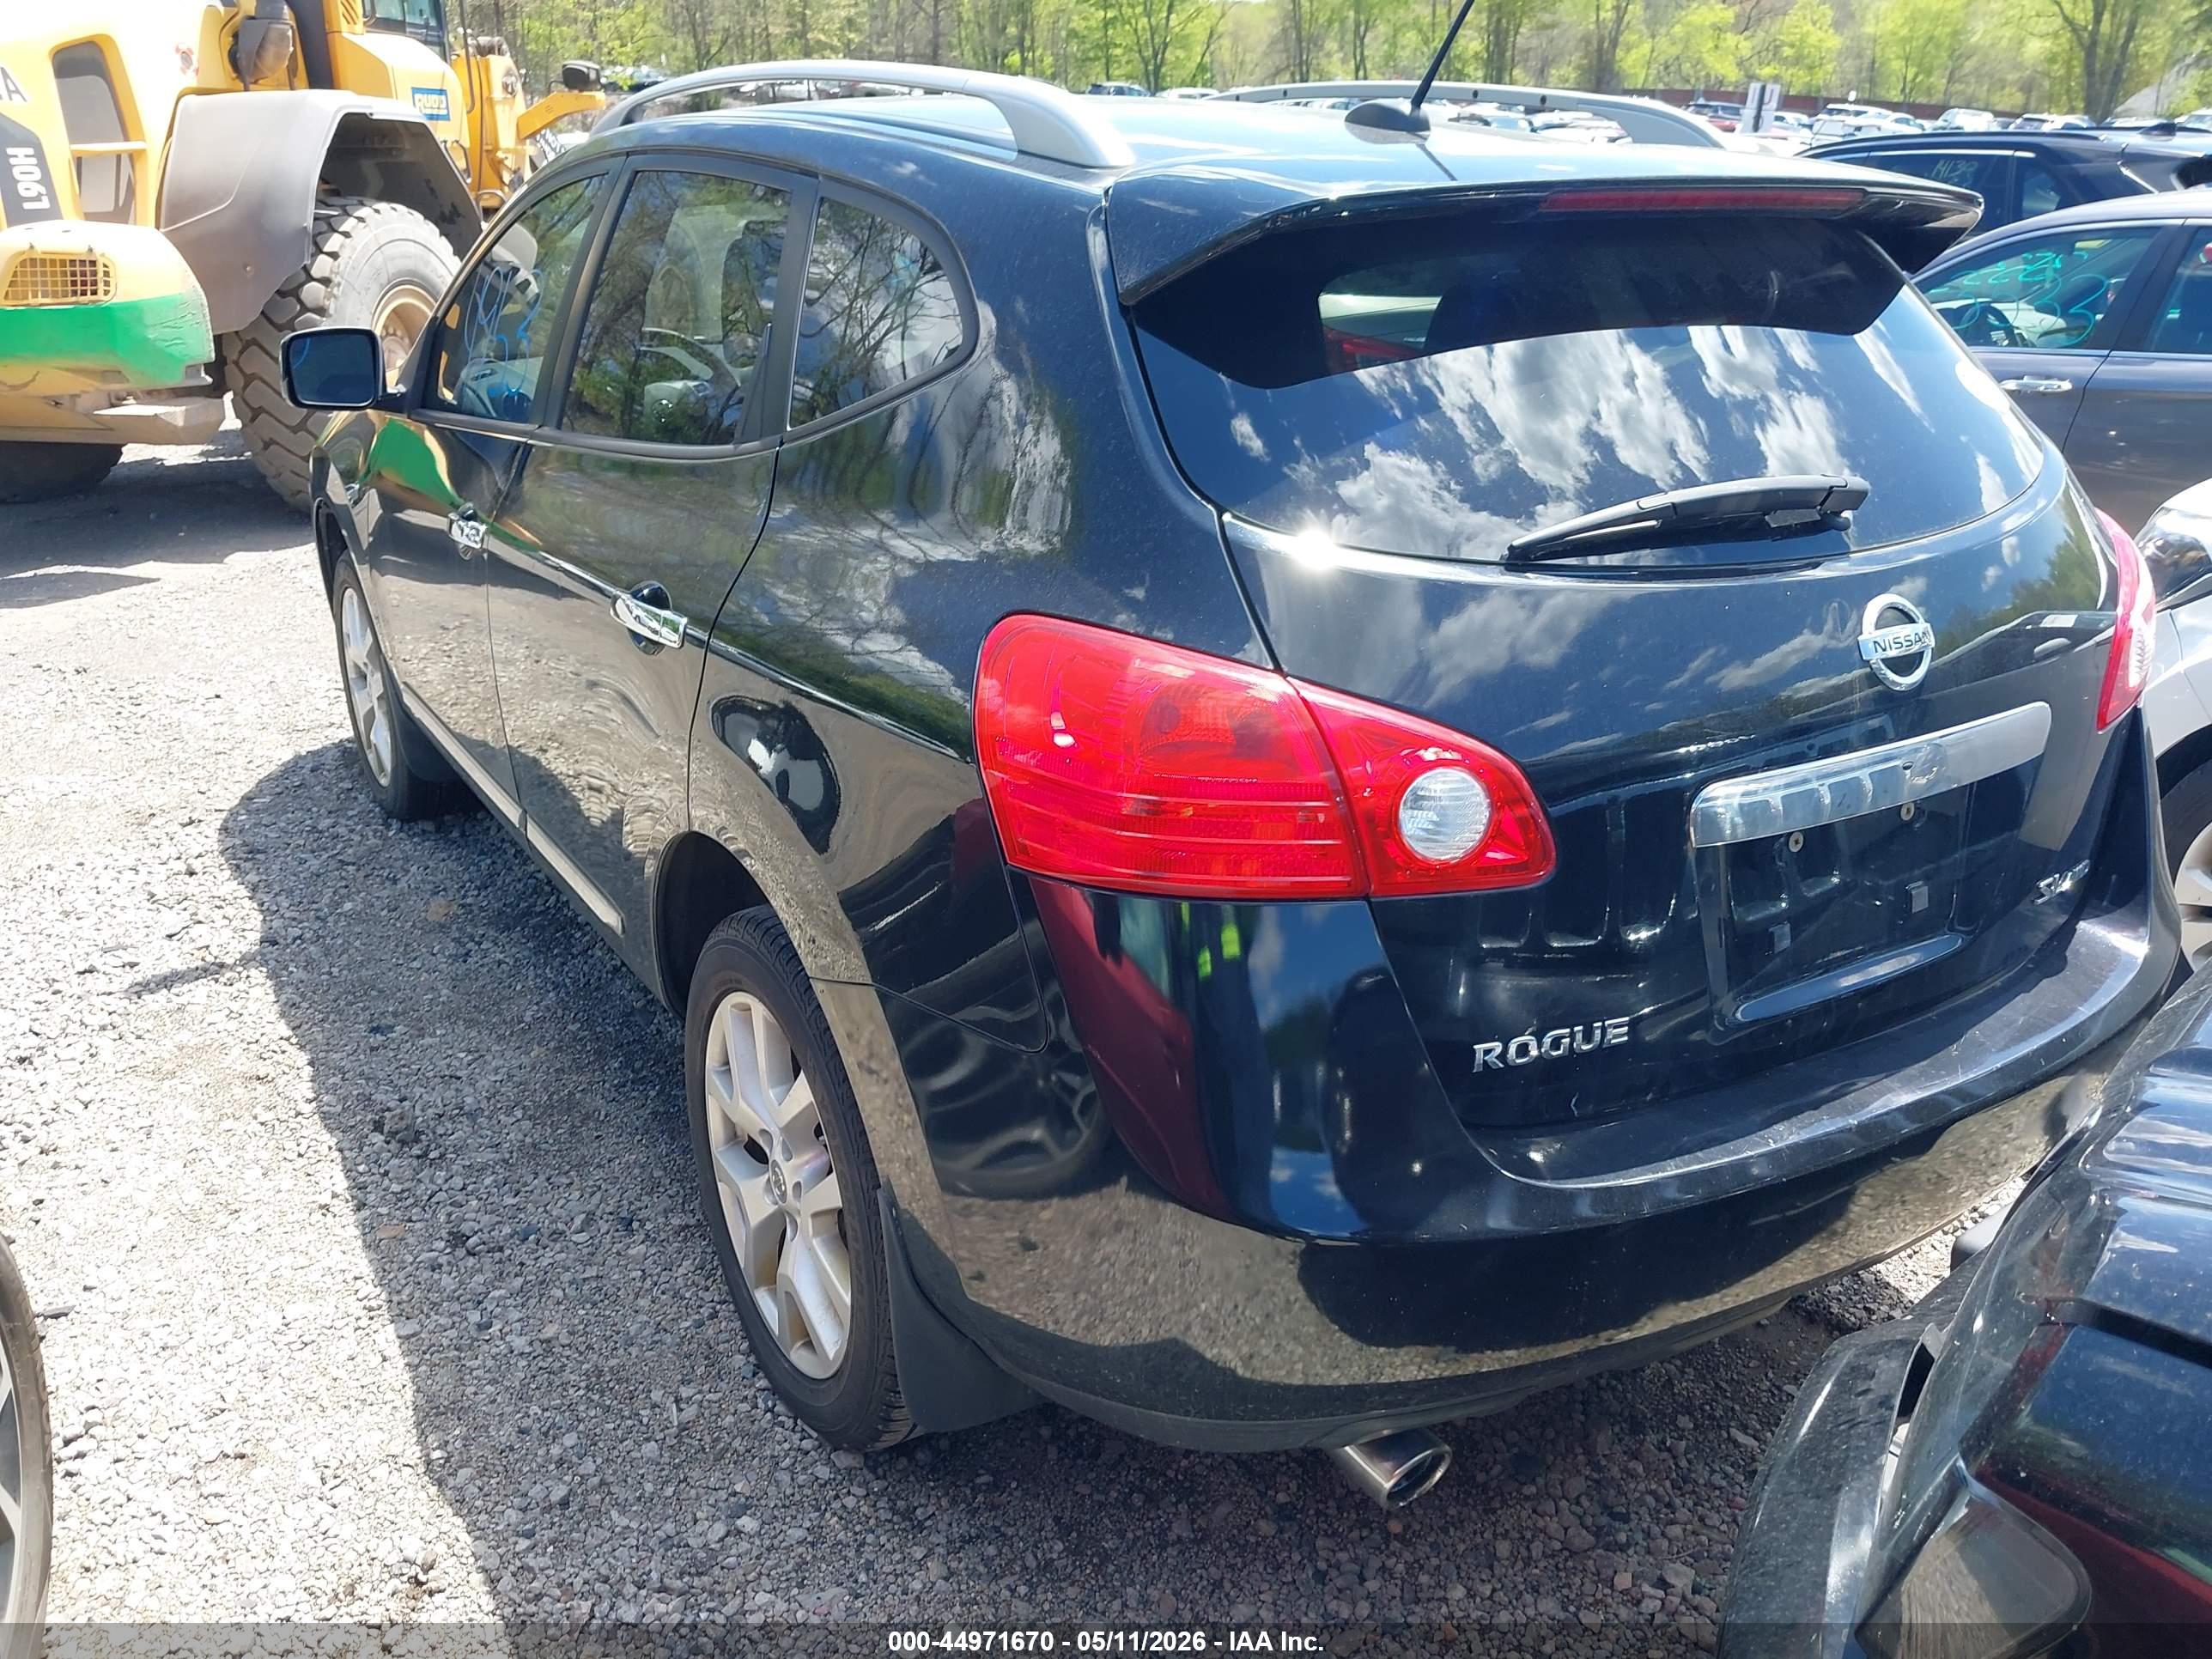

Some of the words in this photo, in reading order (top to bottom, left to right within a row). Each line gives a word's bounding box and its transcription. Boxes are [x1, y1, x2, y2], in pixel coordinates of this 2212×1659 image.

[6, 147, 51, 210] L90H
[1873, 629, 1932, 653] NISSAN
[1472, 1016, 1630, 1073] ROGUE
